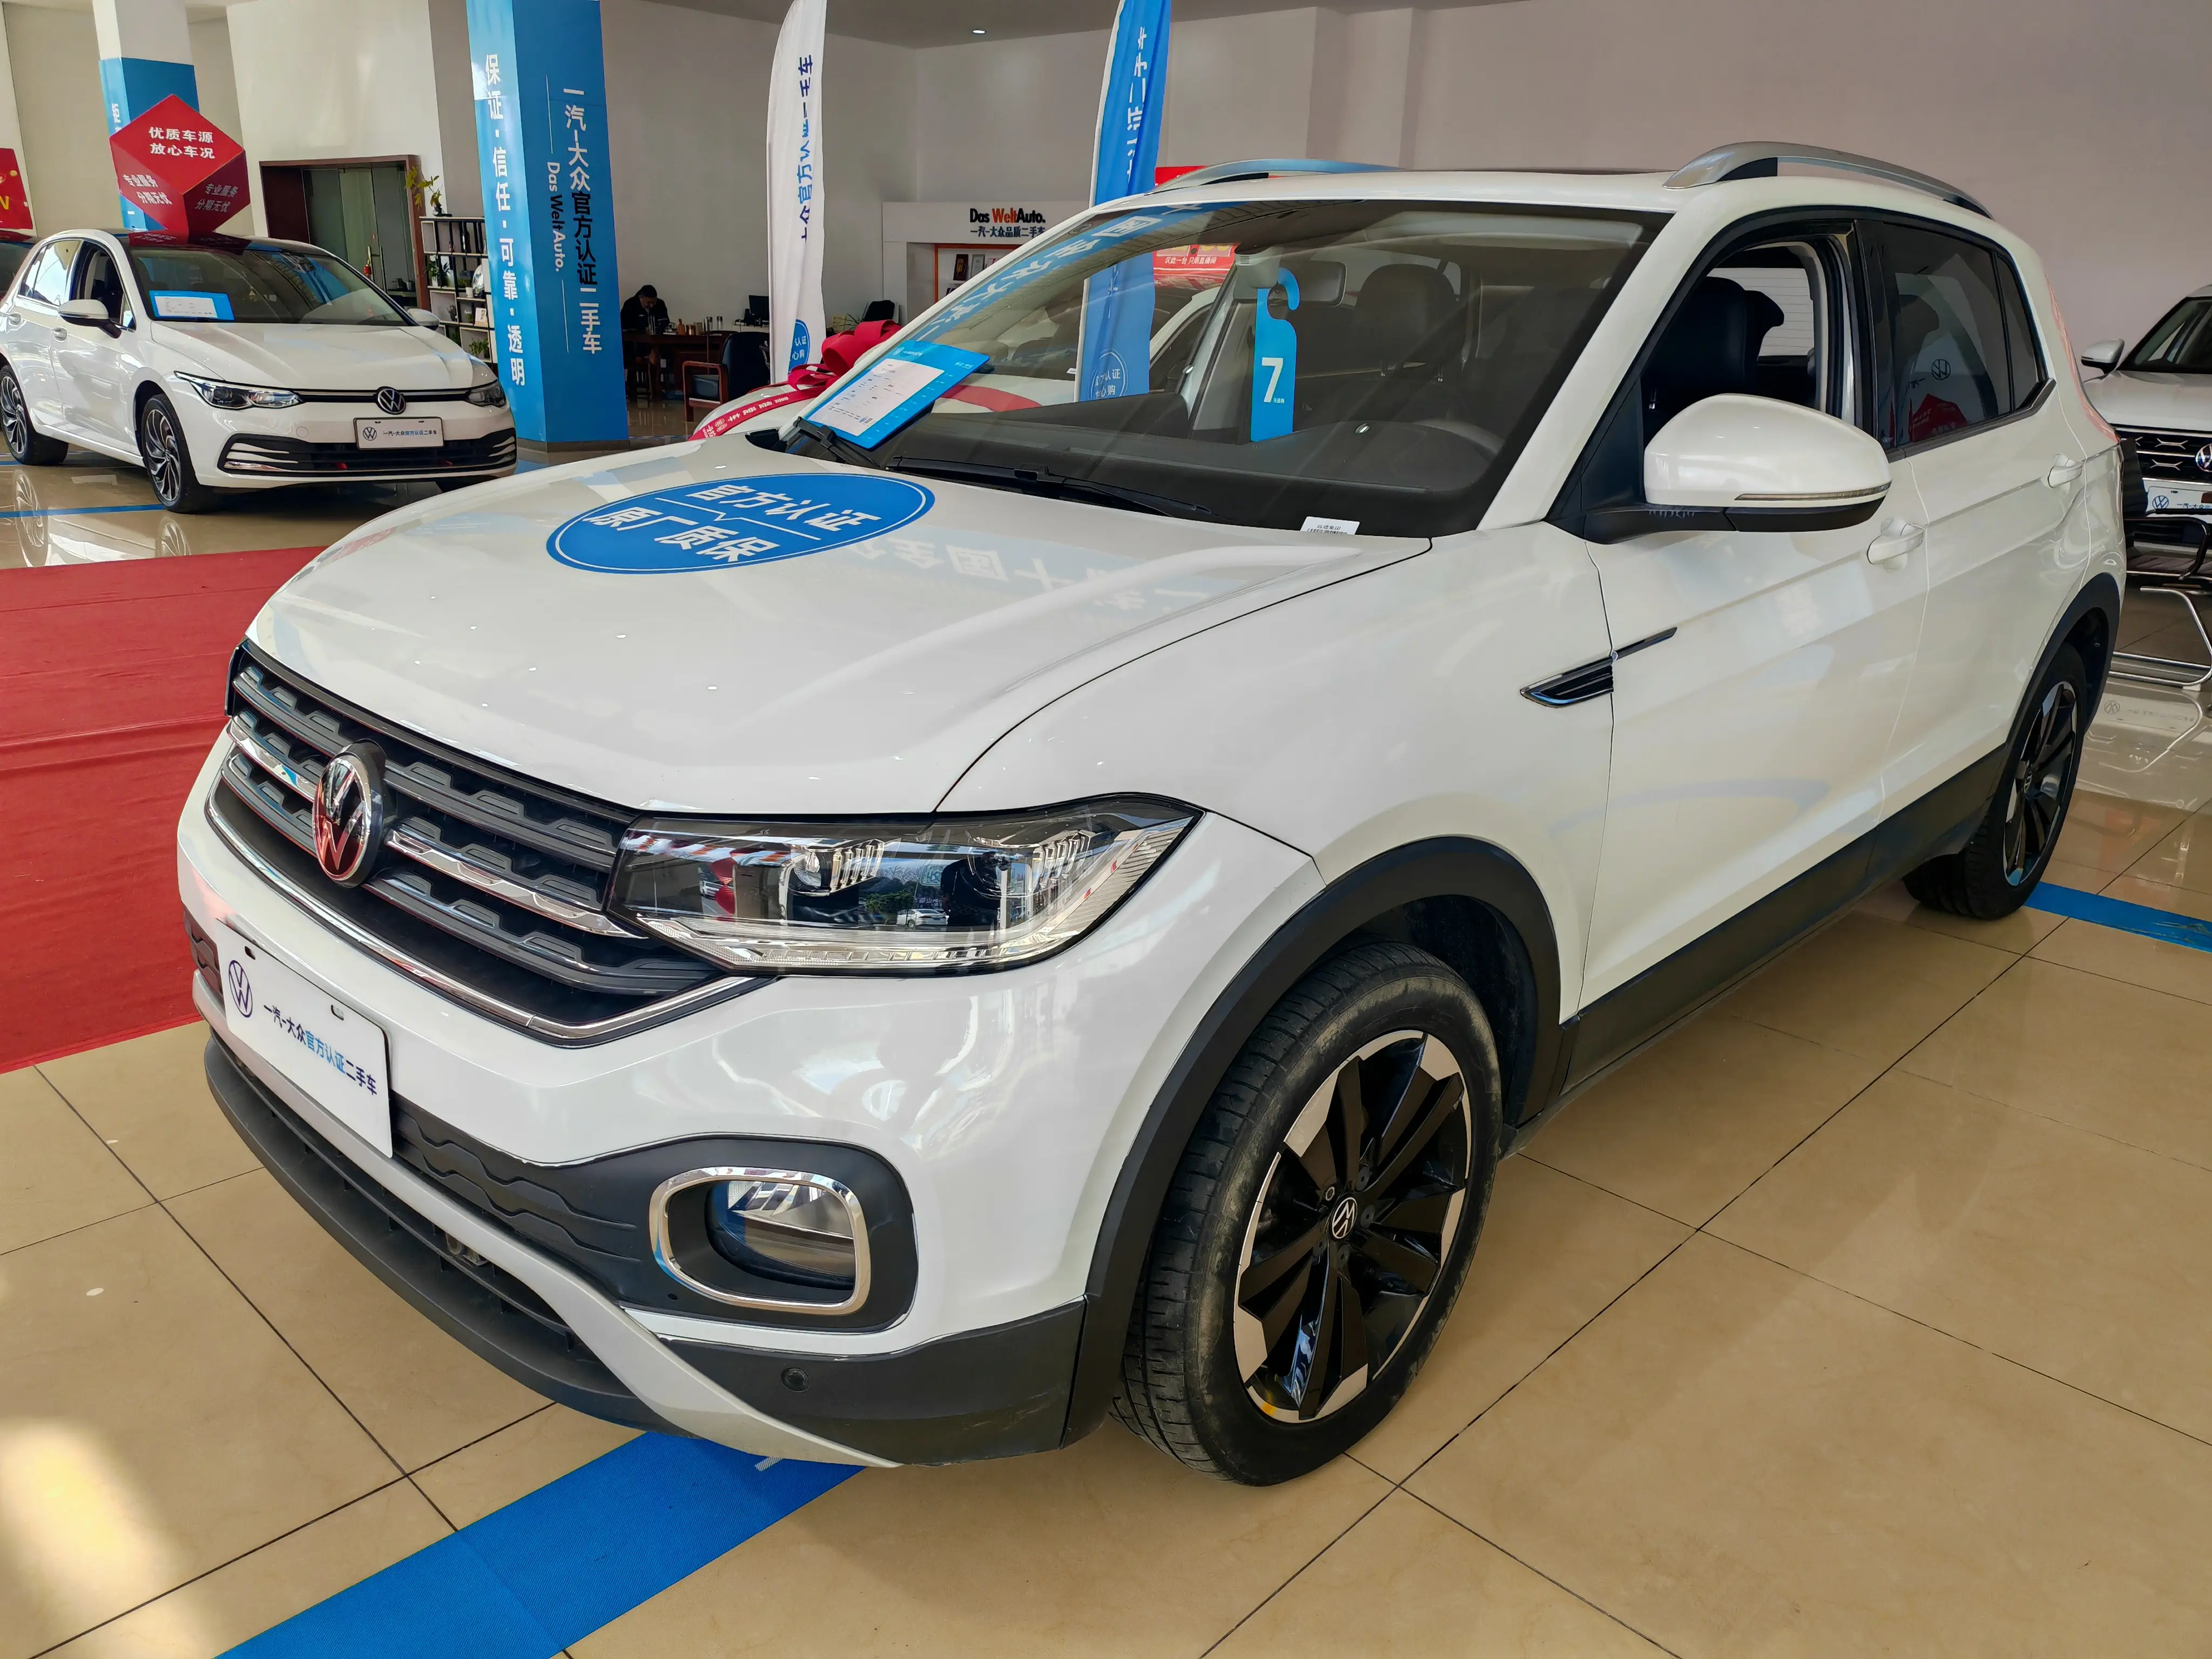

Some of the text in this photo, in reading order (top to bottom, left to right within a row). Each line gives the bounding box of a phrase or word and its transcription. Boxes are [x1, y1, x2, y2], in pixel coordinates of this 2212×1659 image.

[148, 126, 214, 144] 优质车源
[150, 143, 215, 159] 放心车况
[123, 174, 159, 188] 专业服务
[136, 191, 173, 205] 分期无忧
[205, 183, 239, 198] 专业服务
[194, 198, 231, 213] 分期无忧
[547, 162, 567, 272] Das WeltAuto.
[970, 207, 1046, 224] Das WeltAuto.
[1262, 357, 1284, 403] 7
[685, 483, 882, 532] 官方认证
[582, 506, 780, 562] 原厂质保
